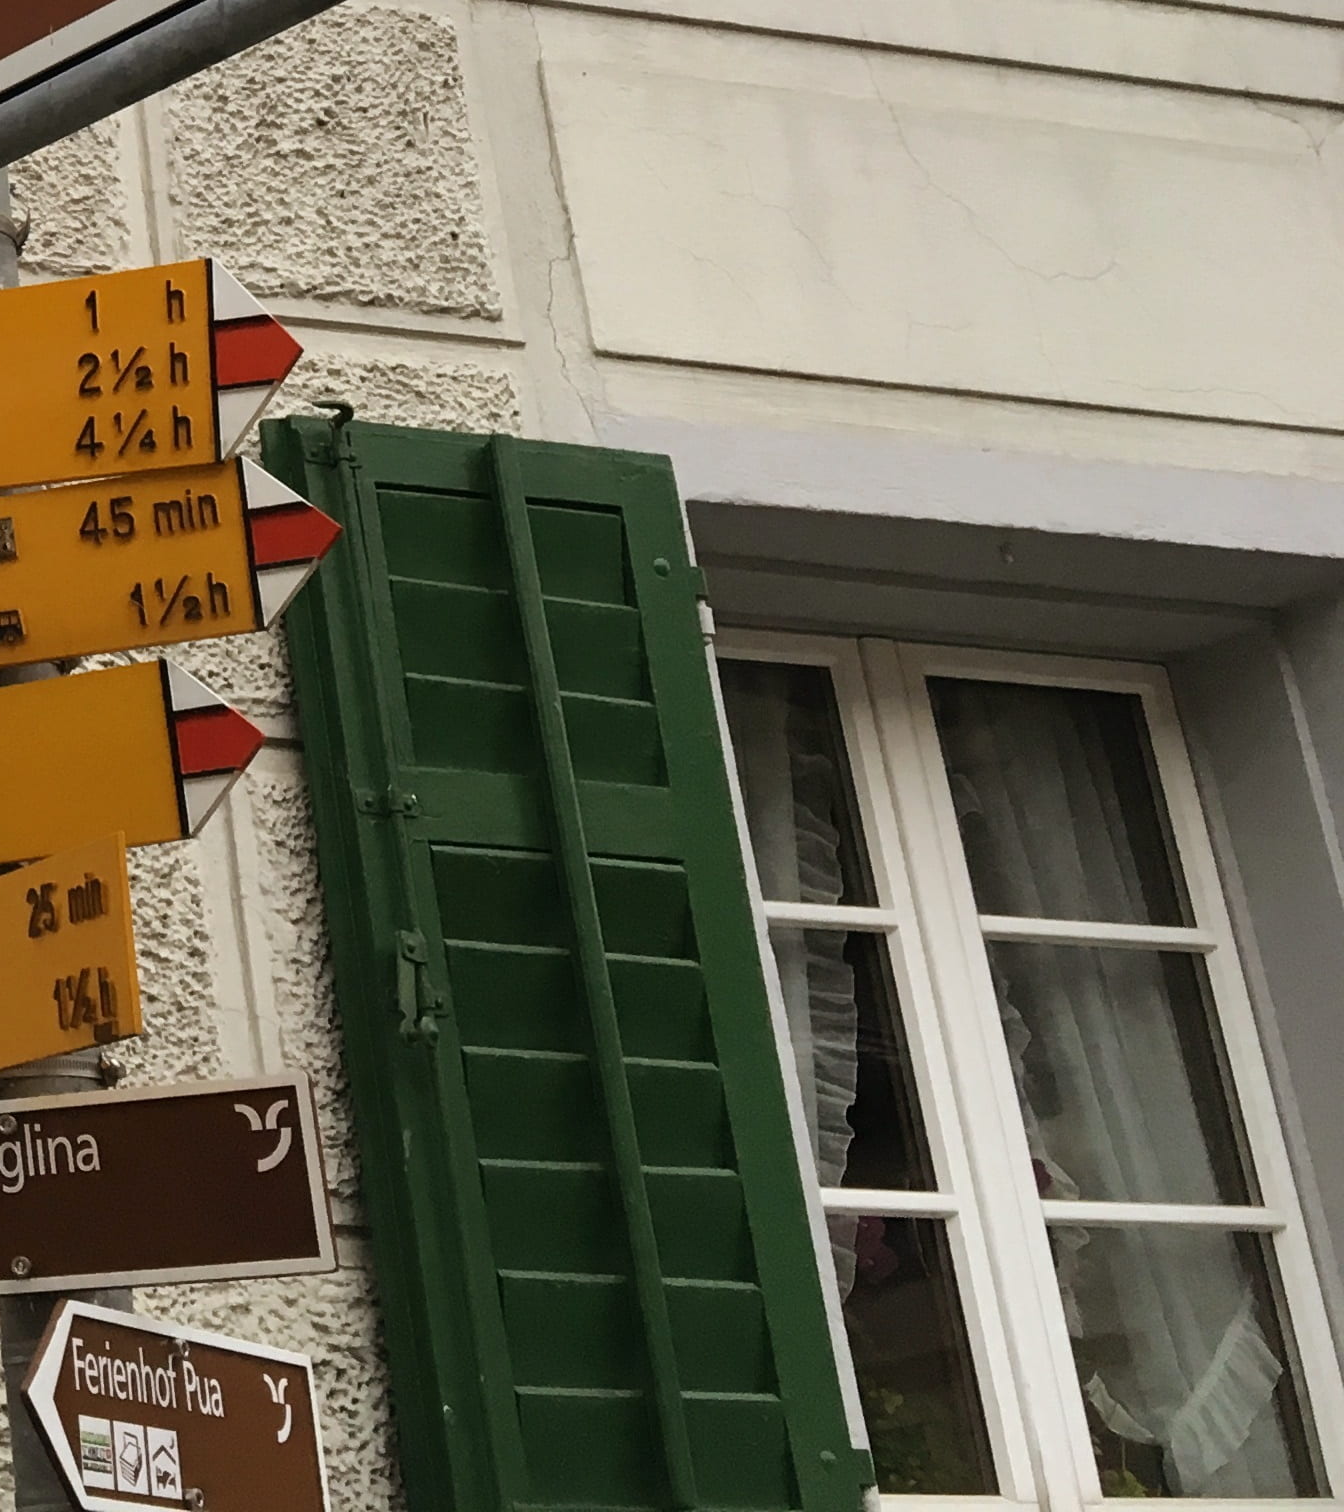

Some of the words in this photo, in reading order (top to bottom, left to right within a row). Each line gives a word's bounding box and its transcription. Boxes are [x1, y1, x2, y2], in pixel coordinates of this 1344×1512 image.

[84, 290, 99, 333] 1
[166, 280, 186, 323] h
[169, 342, 190, 386] h
[172, 405, 193, 450] h
[79, 496, 136, 549] 45
[154, 490, 219, 537] min
[207, 572, 230, 617] h
[72, 1338, 177, 1409] Ferienhof
[183, 1358, 225, 1418] Pua
